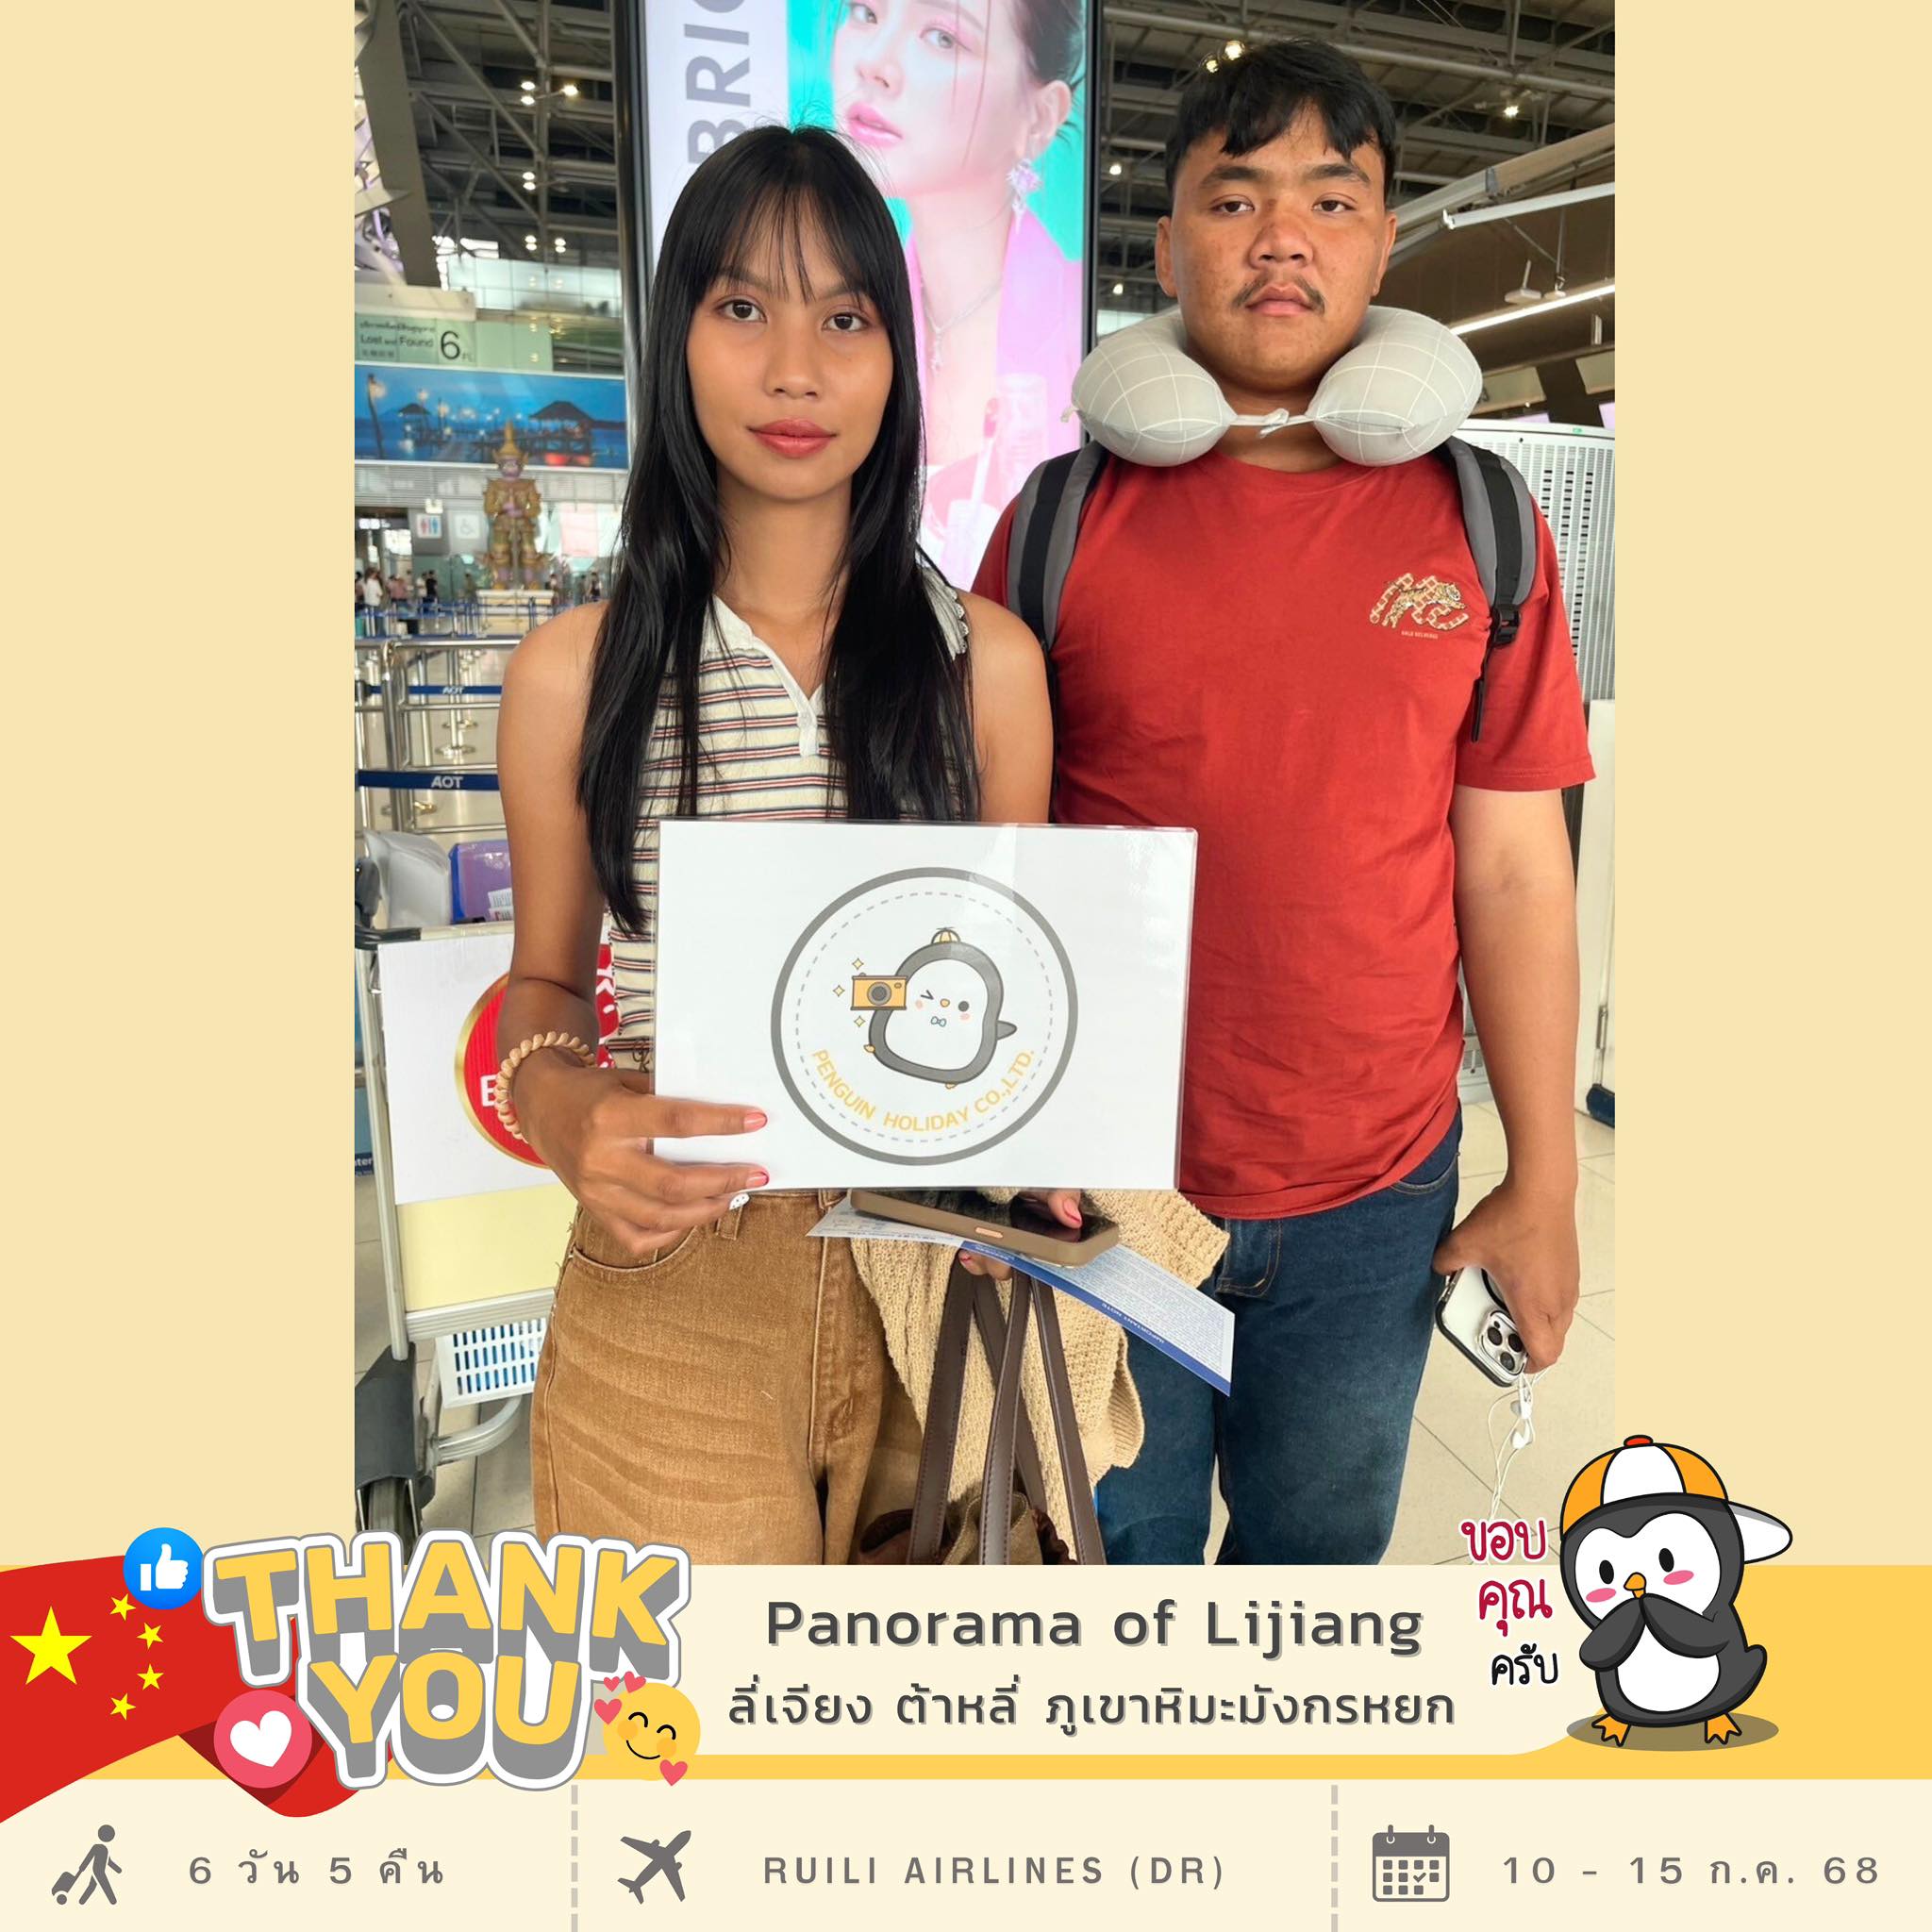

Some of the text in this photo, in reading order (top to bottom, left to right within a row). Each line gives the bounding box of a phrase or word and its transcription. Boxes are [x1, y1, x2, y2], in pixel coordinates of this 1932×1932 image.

[684, 0, 752, 164] BRI
[360, 334, 382, 345] Lost
[399, 336, 434, 347] Found
[441, 330, 460, 360] 6
[431, 775, 463, 789] AOT
[811, 1048, 876, 1121] PENGUIN
[883, 1106, 970, 1132] HOLIDAY
